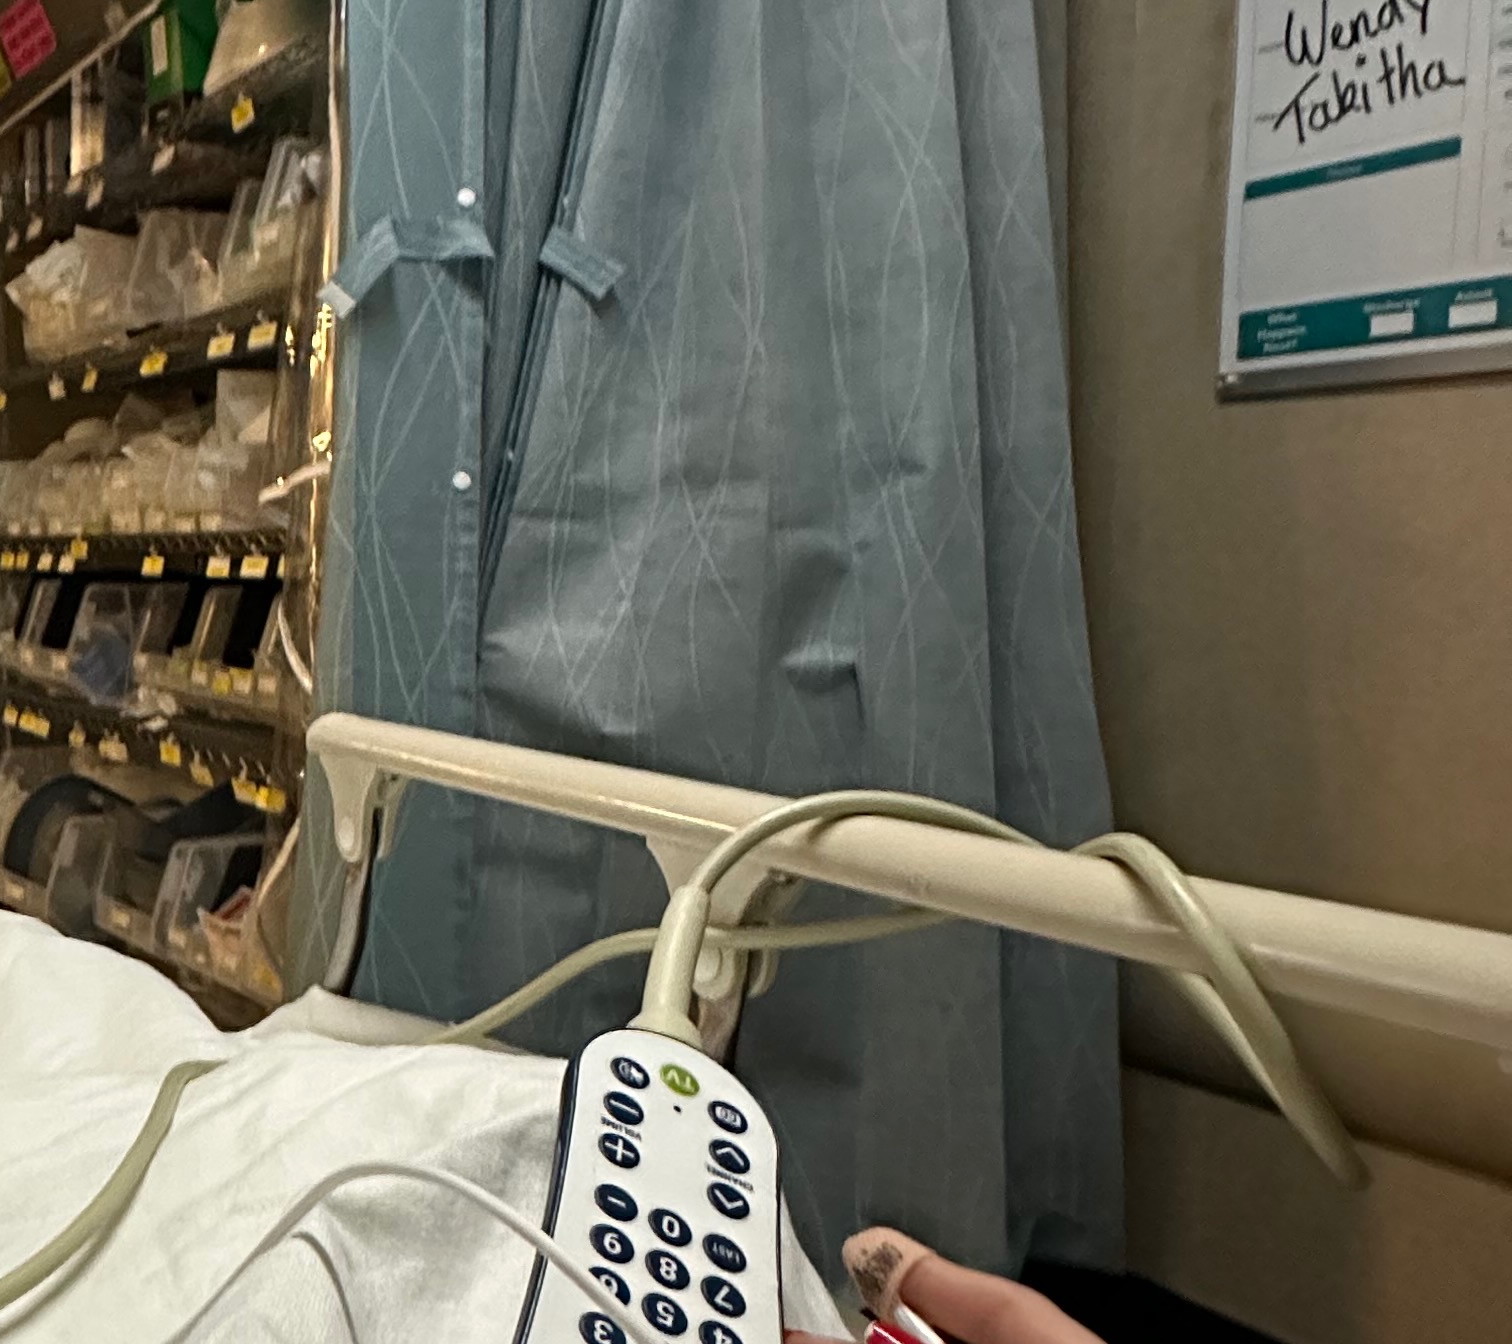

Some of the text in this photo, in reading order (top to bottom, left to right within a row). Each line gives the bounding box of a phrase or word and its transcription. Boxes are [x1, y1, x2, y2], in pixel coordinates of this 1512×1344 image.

[1272, 42, 1466, 144] Tabitha
[666, 1069, 694, 1091] TV
[601, 1116, 642, 1142] VOLUME
[706, 1162, 755, 1193] CHANNEL
[662, 1215, 681, 1238] 0
[603, 1232, 622, 1255] 9
[712, 1242, 740, 1264] LAST
[659, 1256, 678, 1282] 8
[714, 1284, 734, 1311] 7
[656, 1301, 675, 1328] 5
